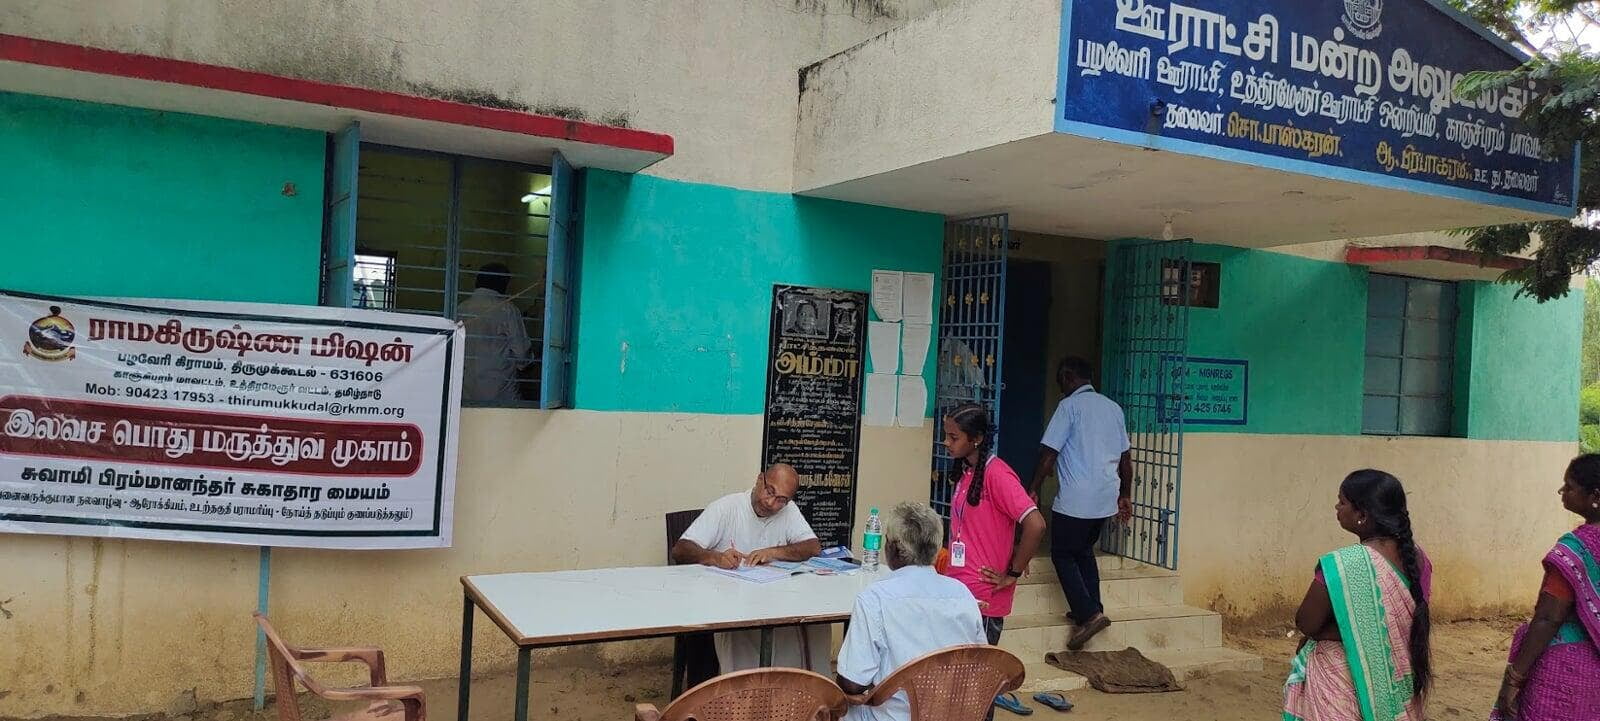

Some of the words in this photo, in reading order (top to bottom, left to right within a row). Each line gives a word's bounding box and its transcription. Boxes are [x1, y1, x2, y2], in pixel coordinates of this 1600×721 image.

[1115, 0, 1279, 63] ஊராட்சி
[1291, 27, 1382, 96] மன்ற
[1077, 38, 1150, 79] பழவேரி
[1157, 56, 1228, 98] ஊராட்சி,
[1446, 113, 1506, 156] காஞ்சிபுரம்
[88, 318, 303, 357] ராமகிருஷ்ண
[311, 332, 414, 366] மிஷன்
[118, 353, 171, 366] பழவேரி
[231, 361, 316, 377] திருமுக்கூடல்
[330, 369, 383, 382] 631606
[775, 351, 858, 378] அம்மா
[85, 383, 120, 396] Mob:
[125, 386, 168, 400] 90423
[173, 390, 214, 403] 17953
[228, 395, 405, 418] thirumukkudal@rkmm.org
[334, 387, 382, 400] தமிழ்நாடு
[4, 408, 106, 444] இலவச
[113, 419, 196, 459] பொது
[202, 423, 325, 466] மருத்துவ
[331, 430, 413, 468] முகாம்
[21, 465, 92, 485] சுவாமி
[98, 468, 235, 497] பிரம்மானந்தர்
[241, 480, 322, 502] சுகாதார
[327, 482, 390, 501] மையம்
